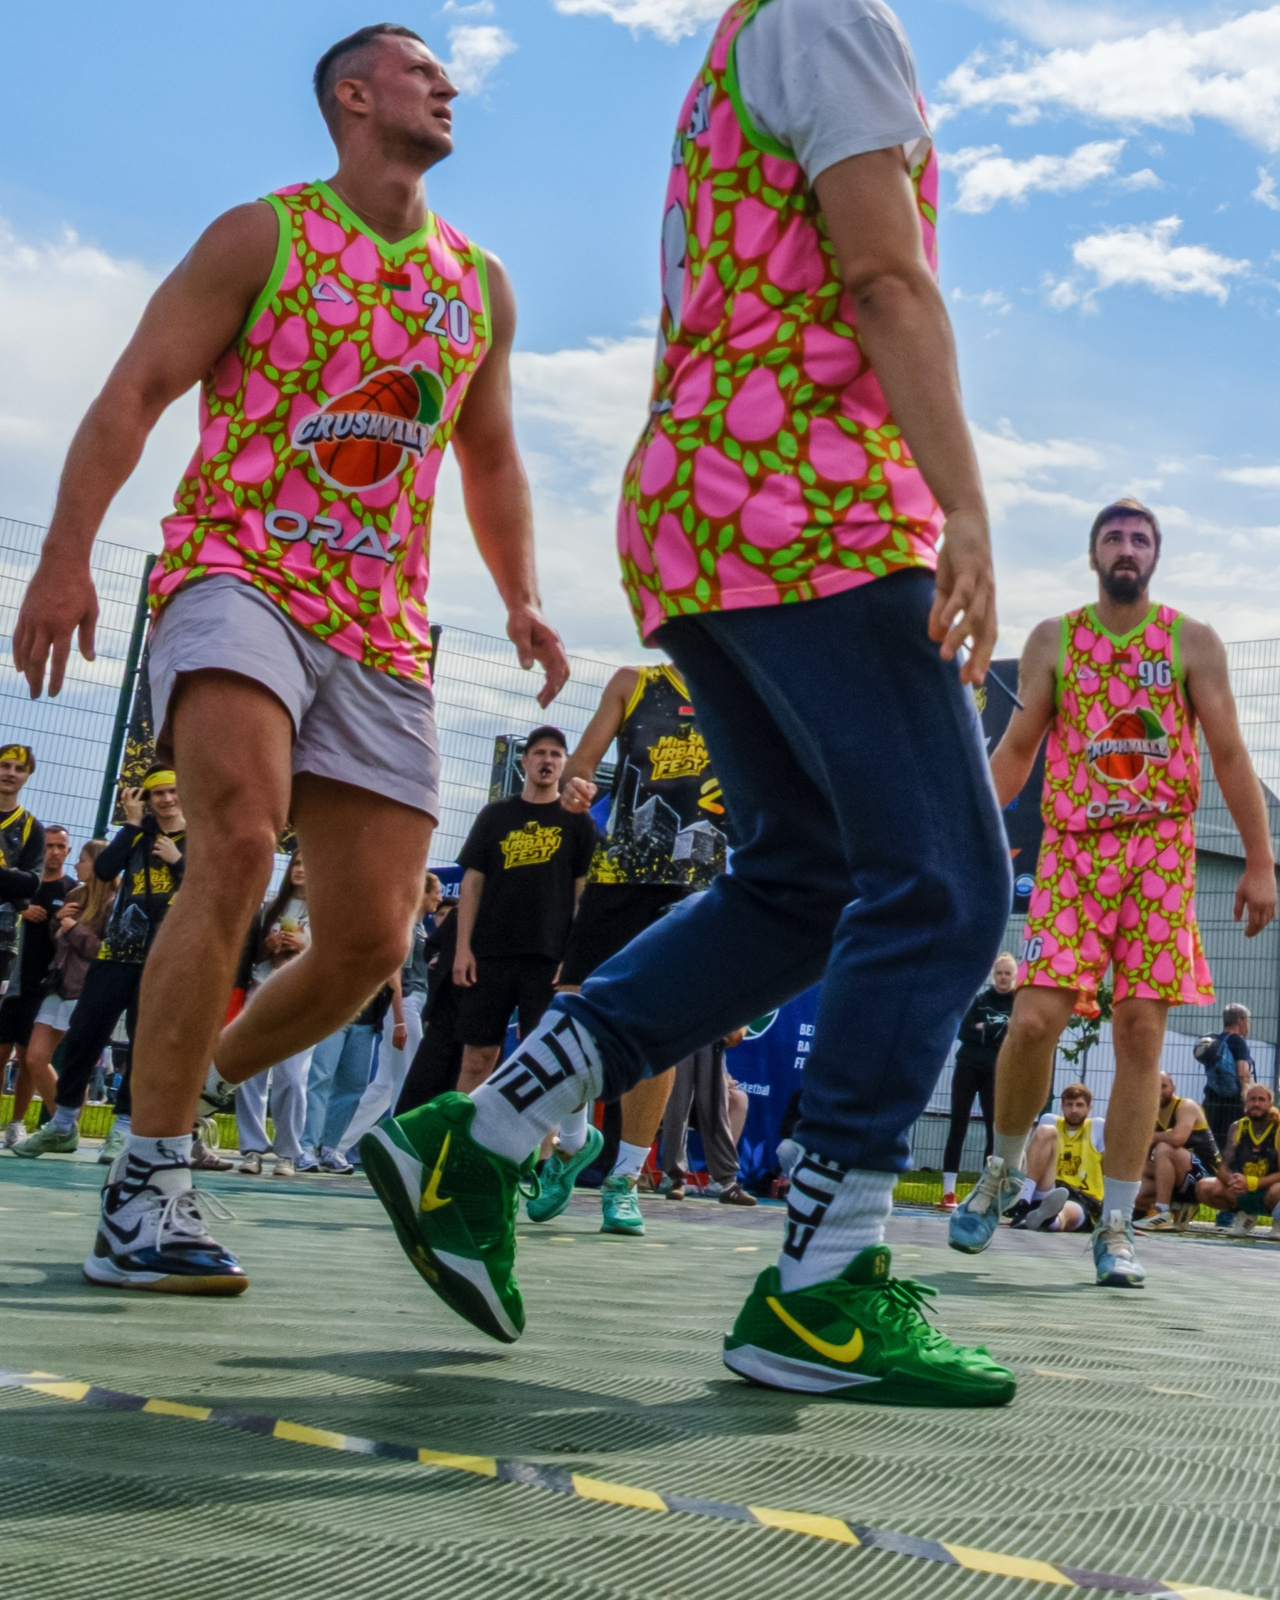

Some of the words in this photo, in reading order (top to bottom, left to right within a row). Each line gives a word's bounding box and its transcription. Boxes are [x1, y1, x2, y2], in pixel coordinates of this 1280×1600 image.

[423, 291, 470, 345] 20
[296, 412, 434, 457] CRUSHVILL
[1137, 659, 1172, 687] 96
